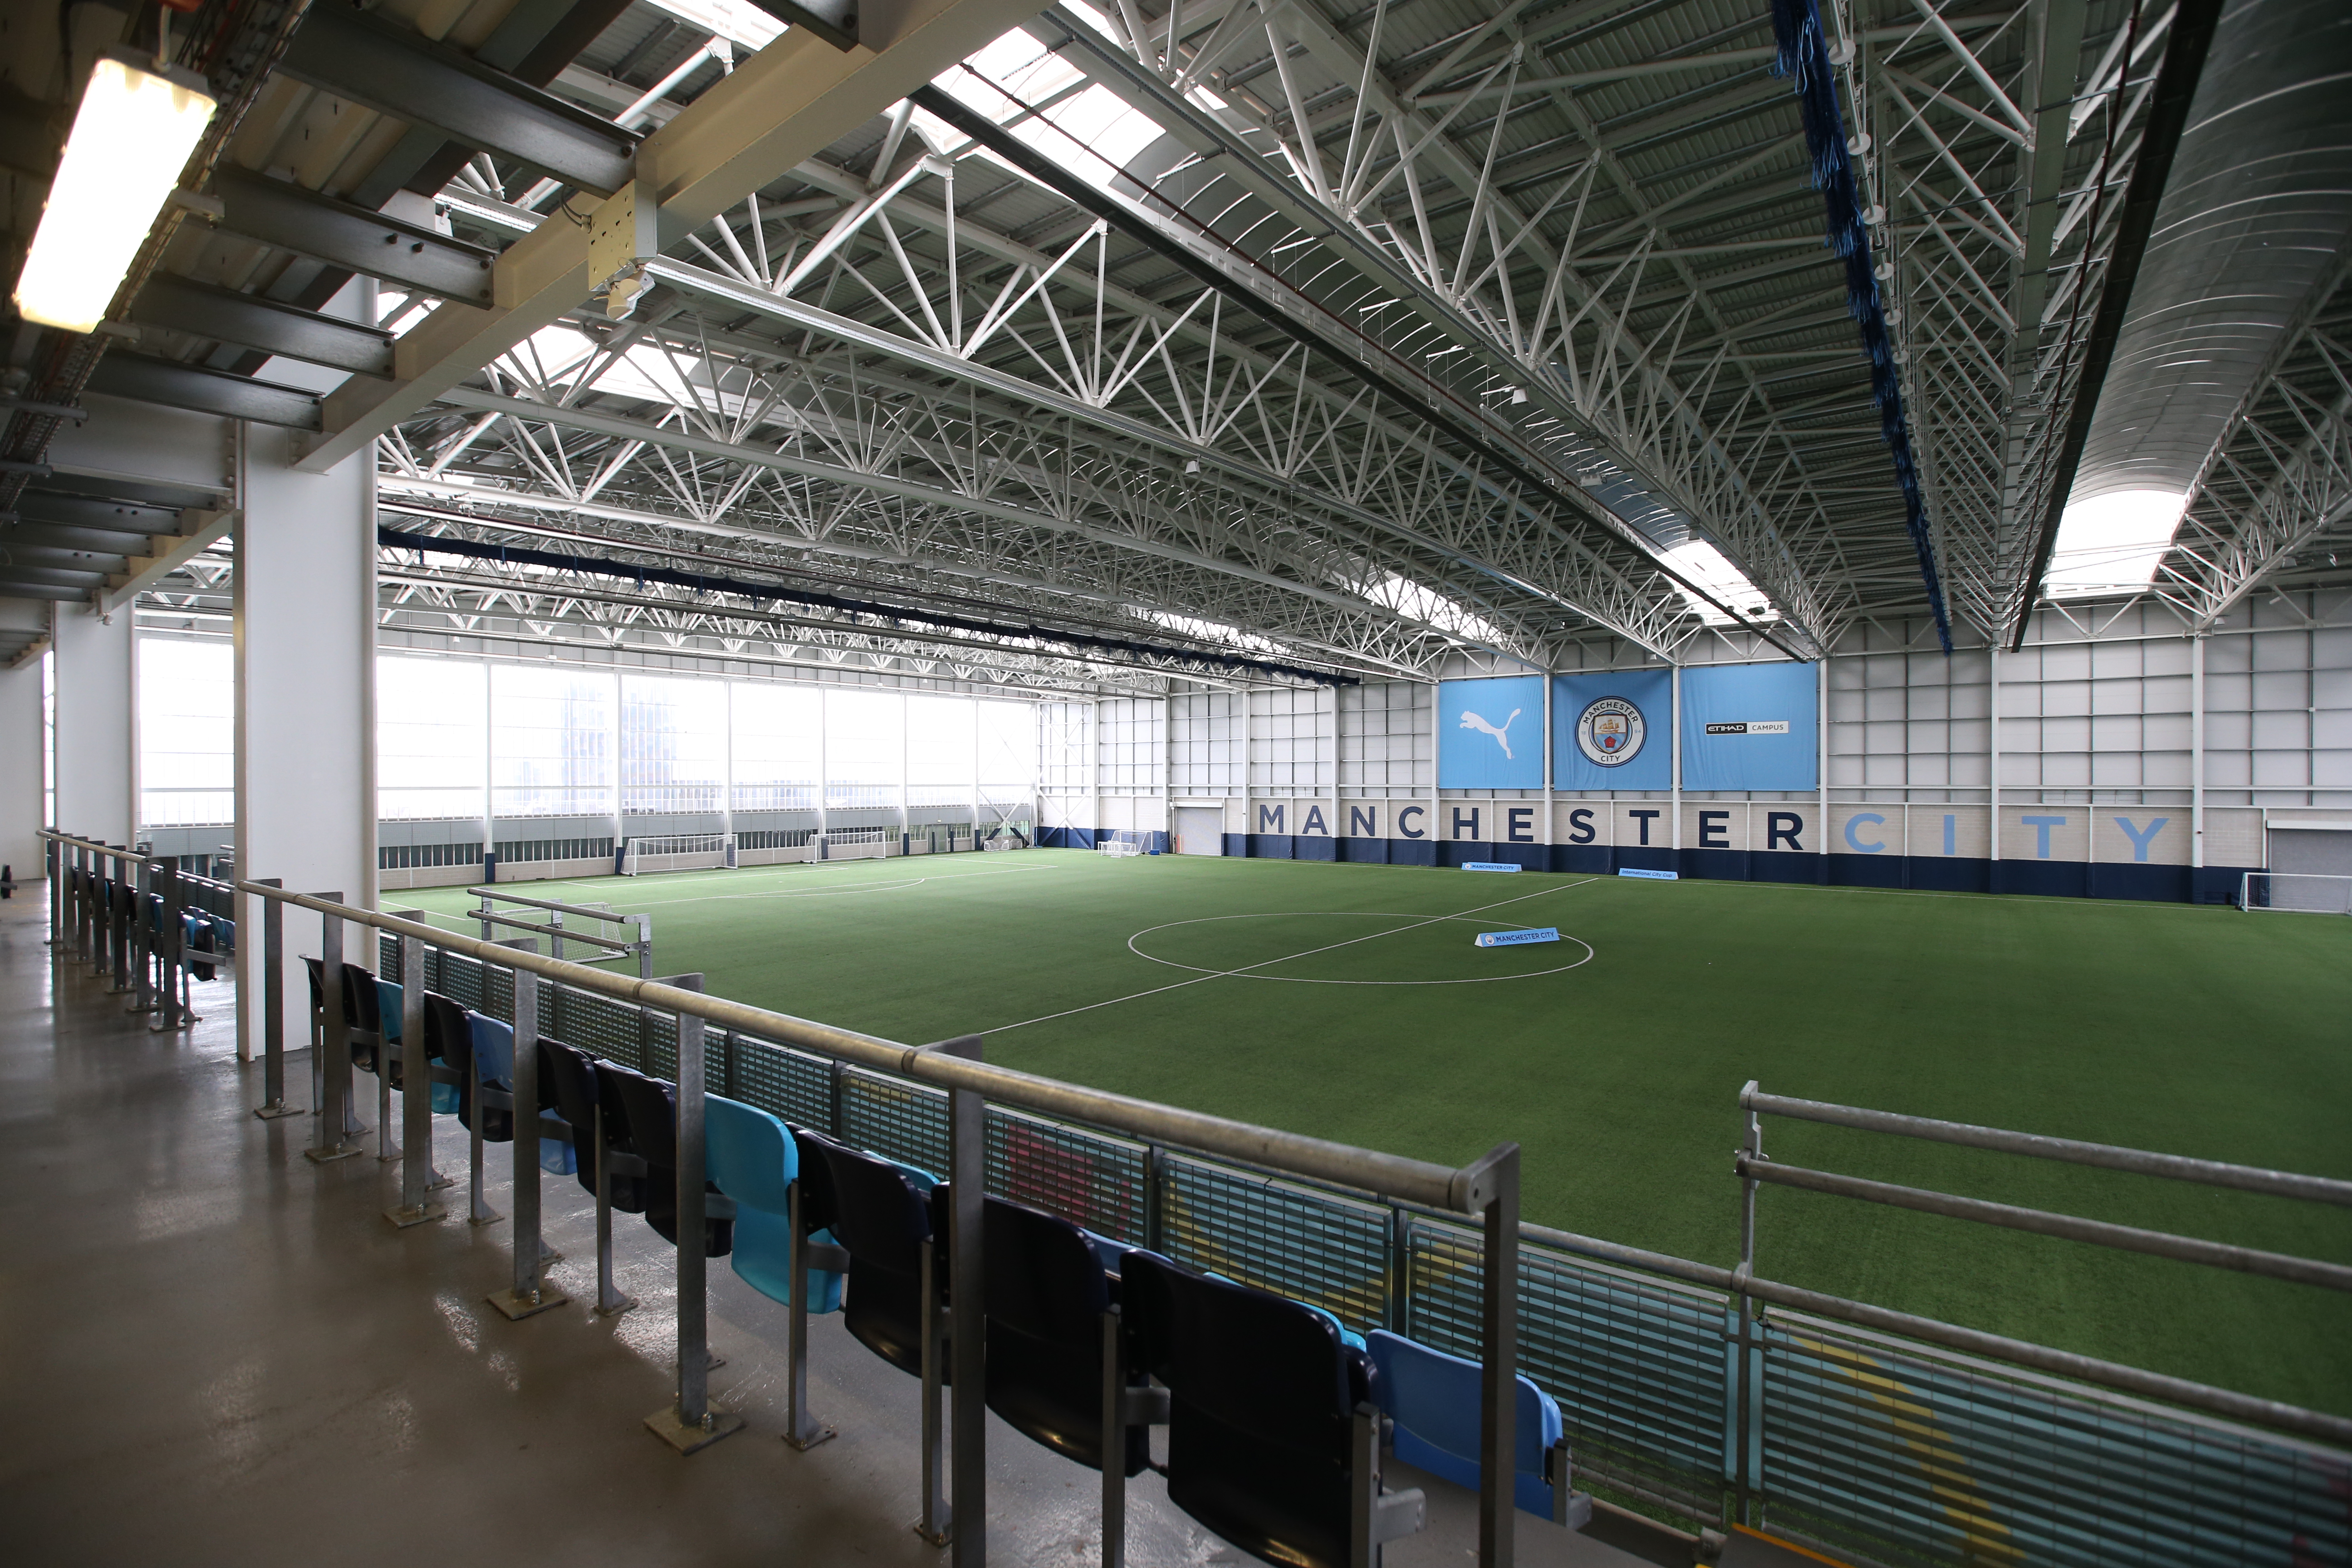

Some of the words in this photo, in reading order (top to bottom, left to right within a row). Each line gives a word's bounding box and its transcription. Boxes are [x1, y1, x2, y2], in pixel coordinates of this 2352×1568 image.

[1583, 701, 1638, 724] MANCHESTER
[1259, 804, 1803, 851] MANCHESTER
[1844, 812, 2170, 862] CITY
[1496, 933, 1540, 942] MANCHESTER
